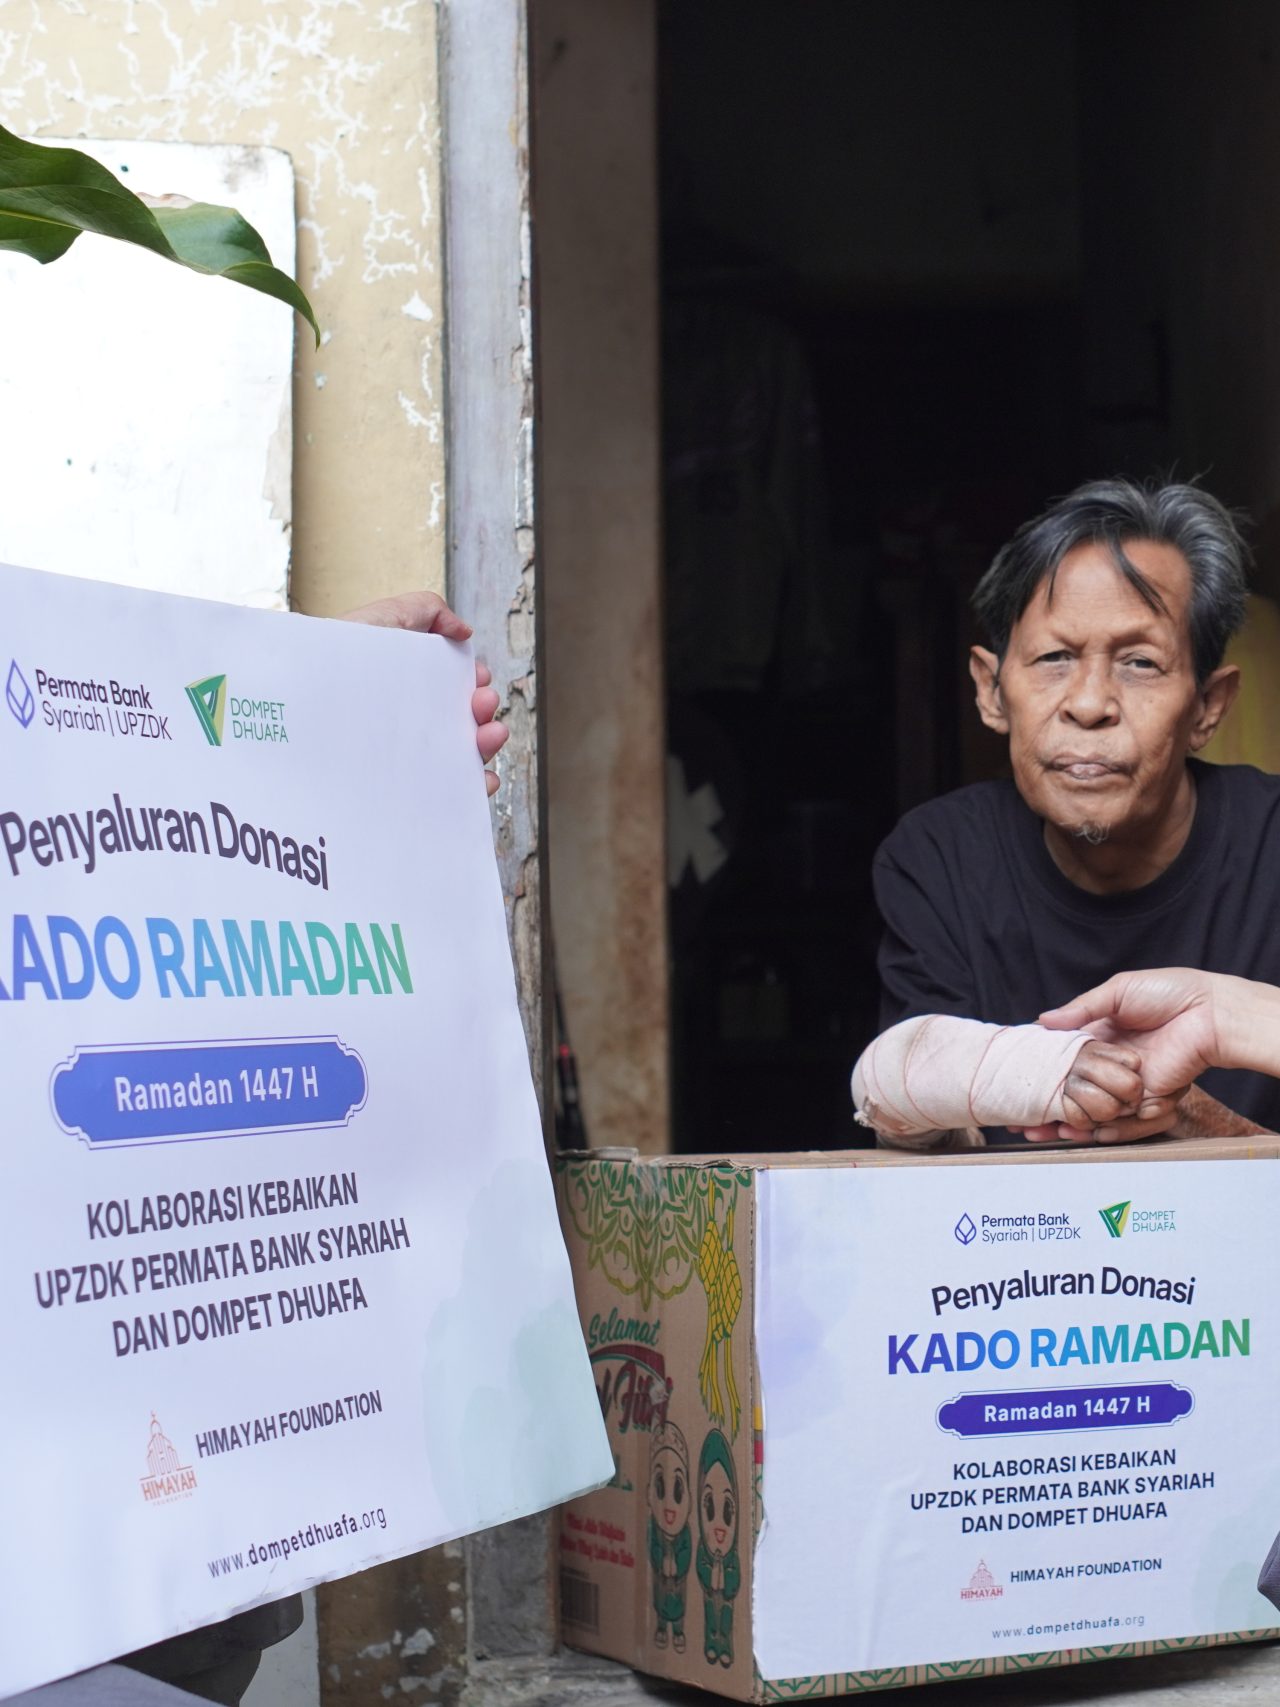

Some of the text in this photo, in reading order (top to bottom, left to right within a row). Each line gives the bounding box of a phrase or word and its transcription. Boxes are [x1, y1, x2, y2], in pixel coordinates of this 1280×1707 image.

[36, 669, 153, 710] Permata Bank
[230, 697, 286, 721] DOMPET
[42, 701, 173, 741] Syariah UPZDK
[232, 720, 289, 743] DHUAFA
[0, 793, 329, 891] Penyaluran Donasi
[0, 914, 414, 1000] ADO RAMADAN
[114, 1065, 319, 1112] Ramadan 1447 H
[87, 1172, 359, 1240] KOLABORASI KEBAIKAN
[981, 1212, 1070, 1228] Permata Bank
[1132, 1210, 1176, 1222] DOMPET
[981, 1226, 1082, 1244] Syariah UPZDK
[1132, 1221, 1177, 1233] DHUAFA
[34, 1217, 411, 1309] UPZDK PERMATA BANK SYARIAH
[931, 1266, 1197, 1316] Penyaluran Donasi
[112, 1277, 369, 1358] DAN DOMPET DHUAFA
[587, 1307, 662, 1349] Selamat
[888, 1318, 1251, 1375] KADO RAMADAN
[195, 1389, 383, 1459] HIMAYAH FOUNDATION
[984, 1396, 1151, 1422] Ramadan 1447 H
[953, 1448, 1177, 1481] KOLABORASI KEBAIKAN
[141, 1470, 198, 1501] HIMAYAH
[910, 1471, 1215, 1511] UPZDK PERMATA BANK SYARIAH
[961, 1501, 1168, 1534] DAN DOMPET DHUAFA
[207, 1507, 388, 1579] www.dompetdhuafa.org
[1010, 1558, 1163, 1583] HIMAYAH FOUNDATION
[960, 1587, 1003, 1600] HIMAYAH
[992, 1614, 1145, 1639] www.dompetdhuafa.org
